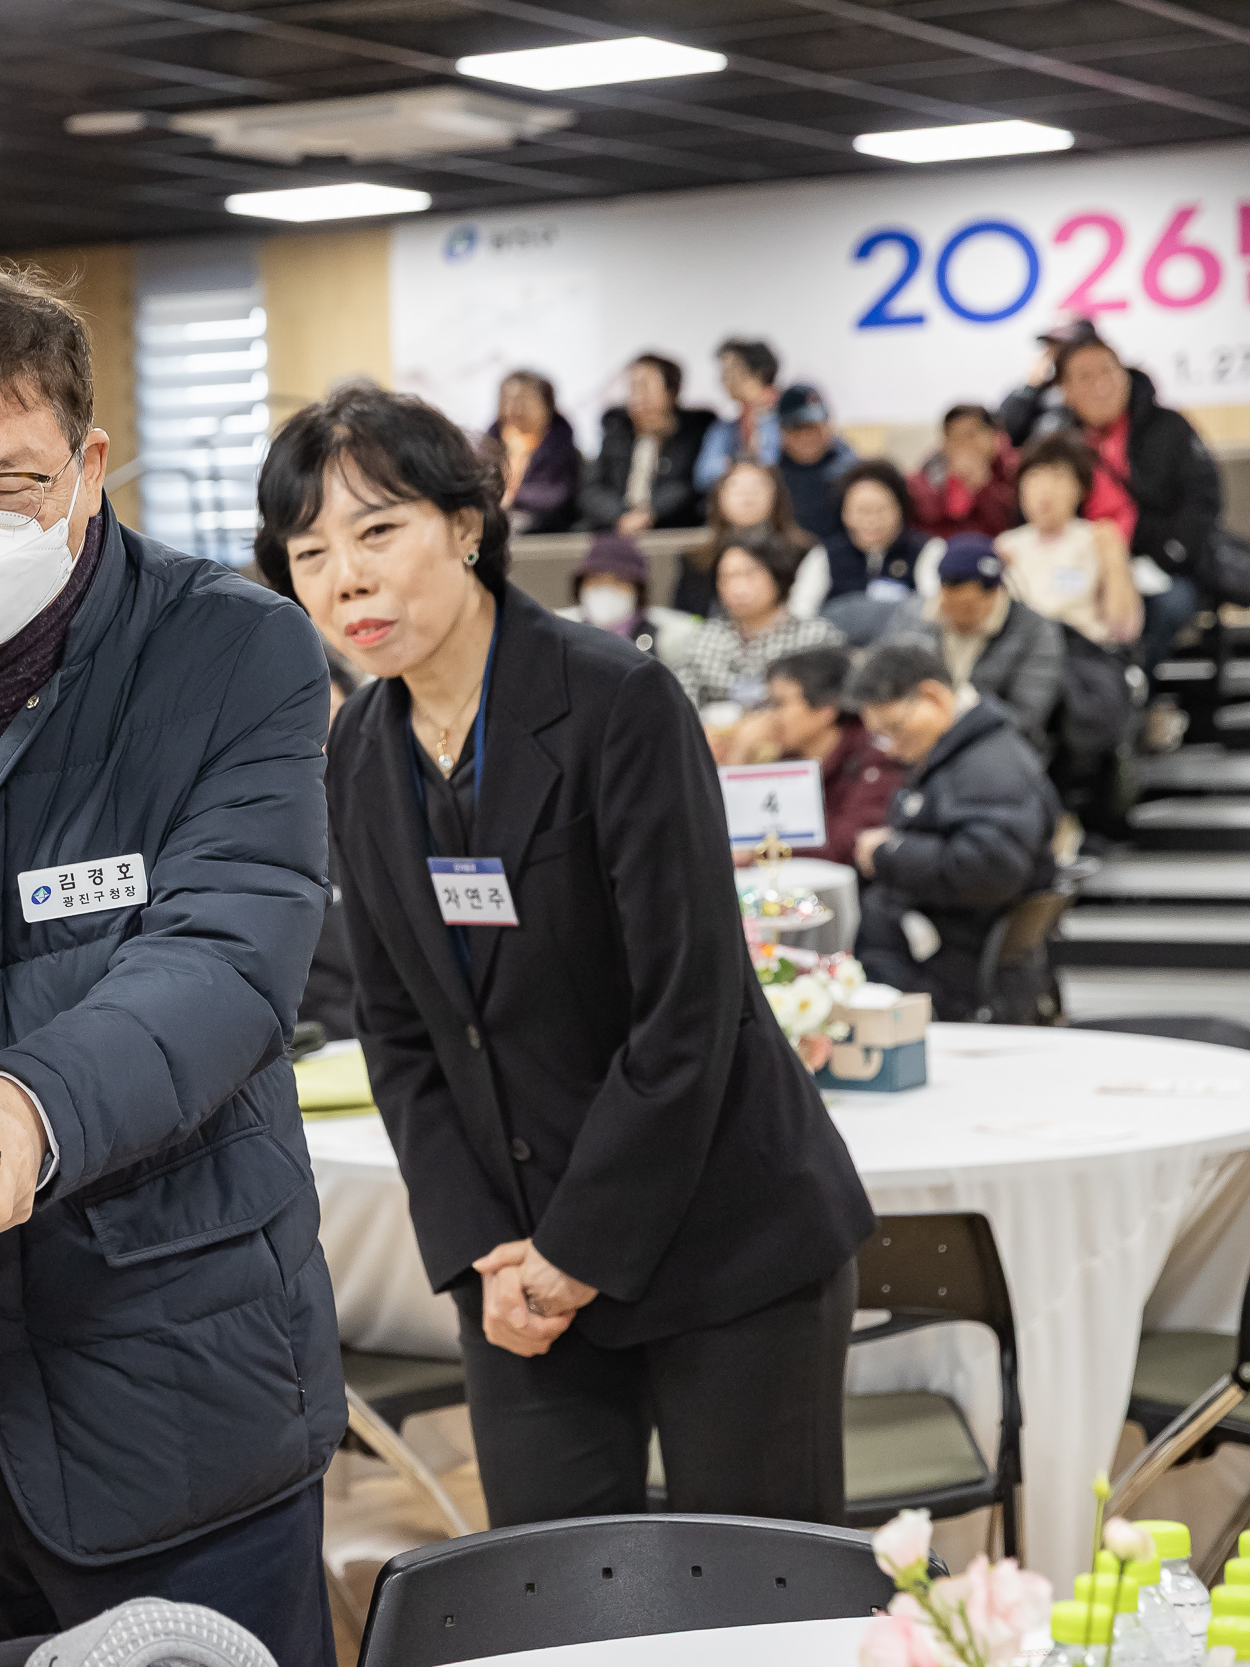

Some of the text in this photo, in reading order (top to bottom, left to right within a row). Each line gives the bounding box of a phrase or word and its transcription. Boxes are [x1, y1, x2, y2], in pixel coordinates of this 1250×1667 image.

[855, 203, 1250, 328] 2026
[58, 862, 134, 891] 김경호
[62, 885, 136, 908] 광진구청장
